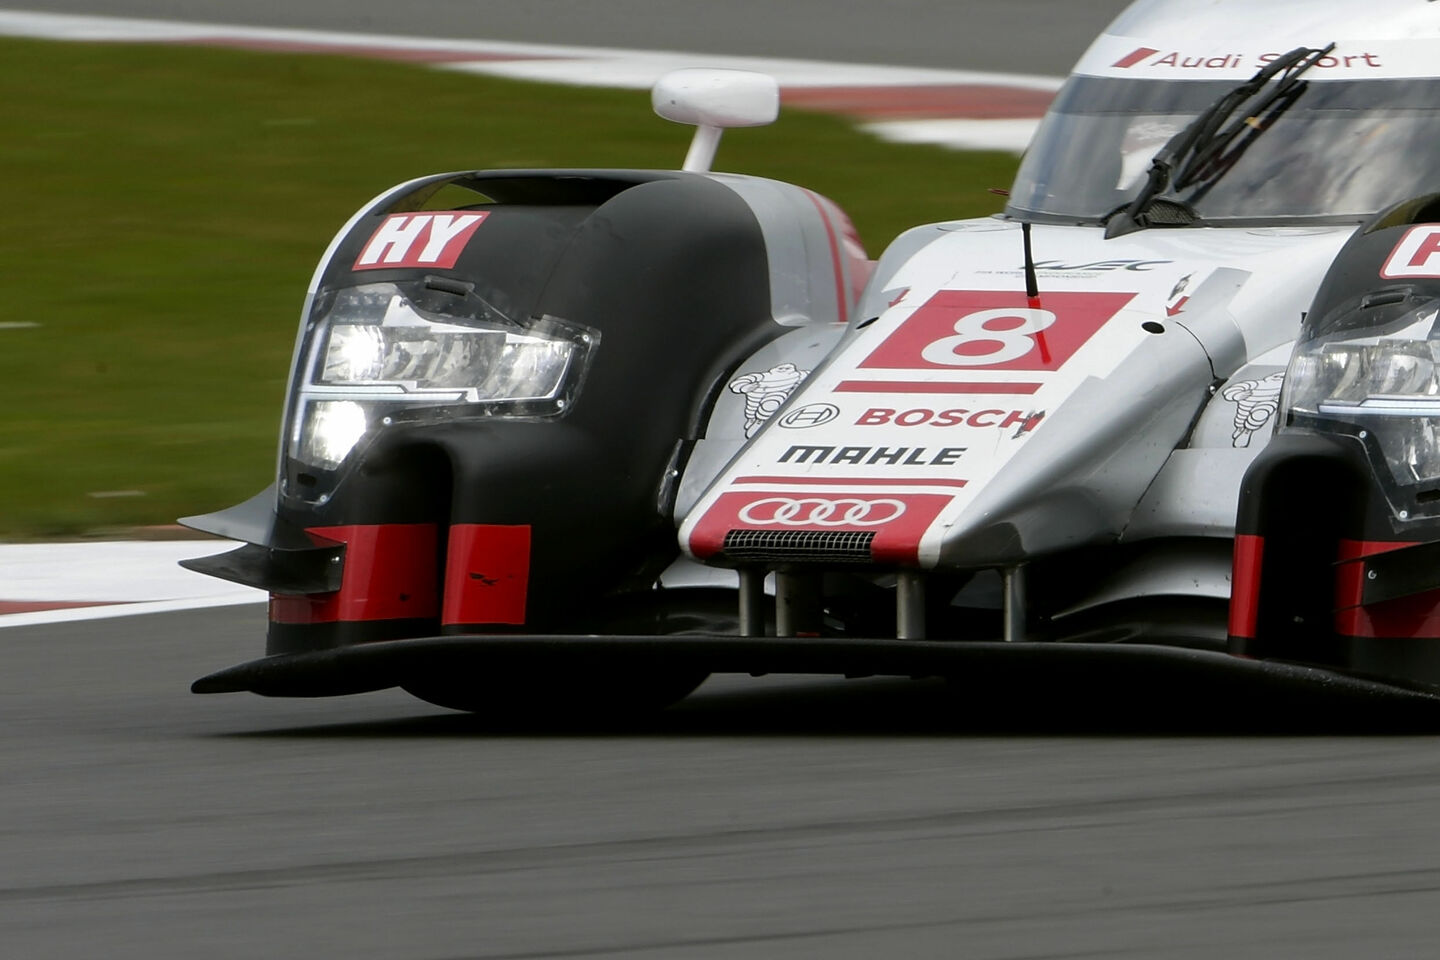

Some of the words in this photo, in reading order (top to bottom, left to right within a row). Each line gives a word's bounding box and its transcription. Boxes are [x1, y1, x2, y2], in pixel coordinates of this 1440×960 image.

[1151, 52, 1242, 68] Audi
[1255, 52, 1382, 68] Sort
[359, 214, 482, 265] HY
[921, 307, 1057, 366] 8
[854, 408, 1046, 432] BOSCH
[777, 445, 968, 466] MAHLE
